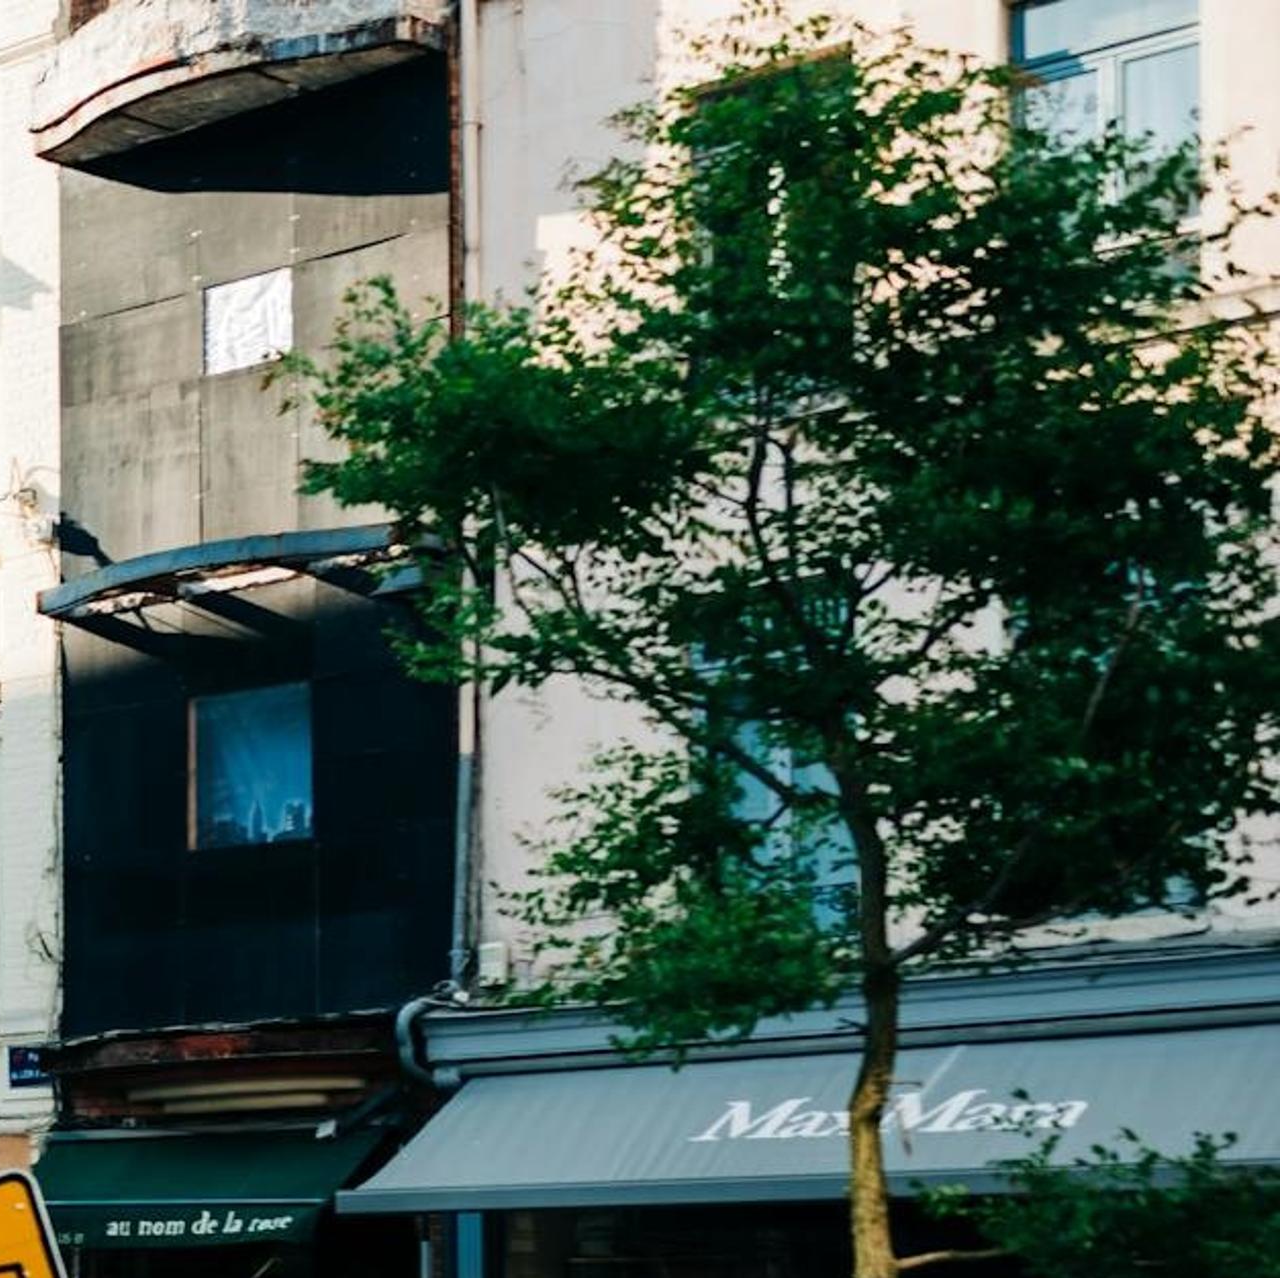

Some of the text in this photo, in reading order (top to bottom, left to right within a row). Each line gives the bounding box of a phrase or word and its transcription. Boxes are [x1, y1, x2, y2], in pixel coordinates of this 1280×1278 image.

[106, 1210, 293, 1236] au nom de la rose
